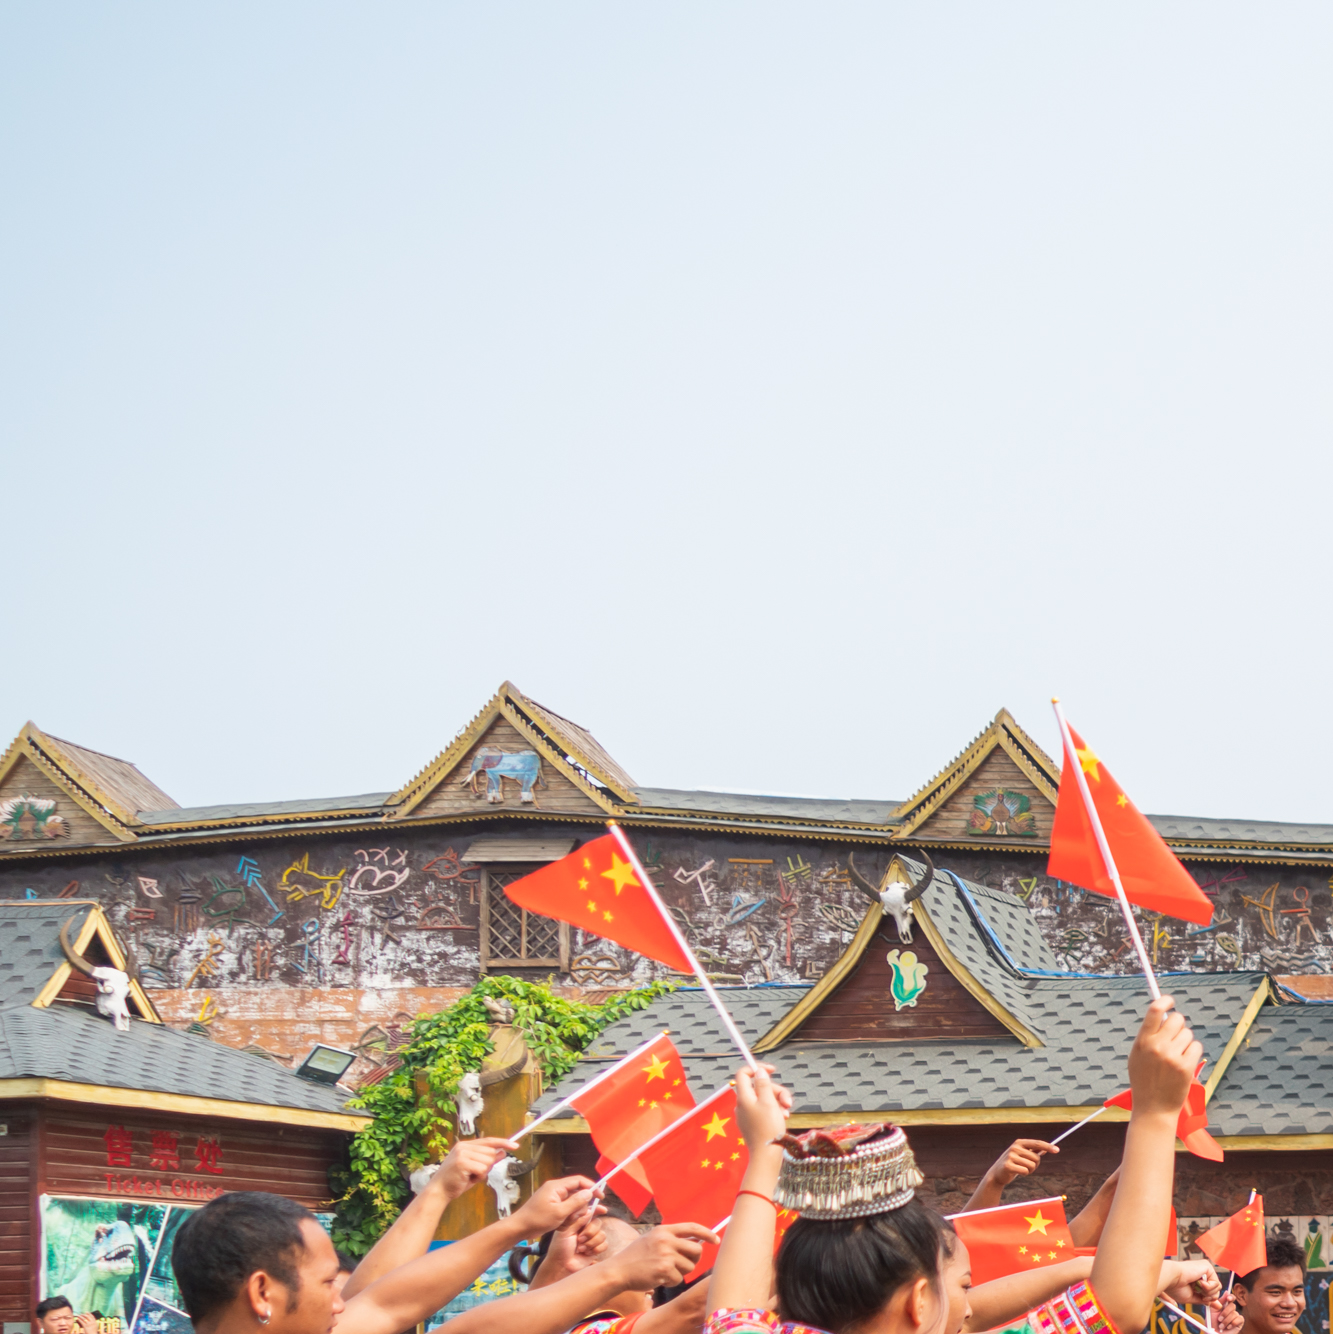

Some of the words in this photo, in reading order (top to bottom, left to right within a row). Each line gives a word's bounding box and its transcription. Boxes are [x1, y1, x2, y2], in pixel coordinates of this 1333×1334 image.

[103, 1125, 224, 1174] 售票处
[103, 1173, 162, 1195] Ticket
[171, 1178, 224, 1199] Office
